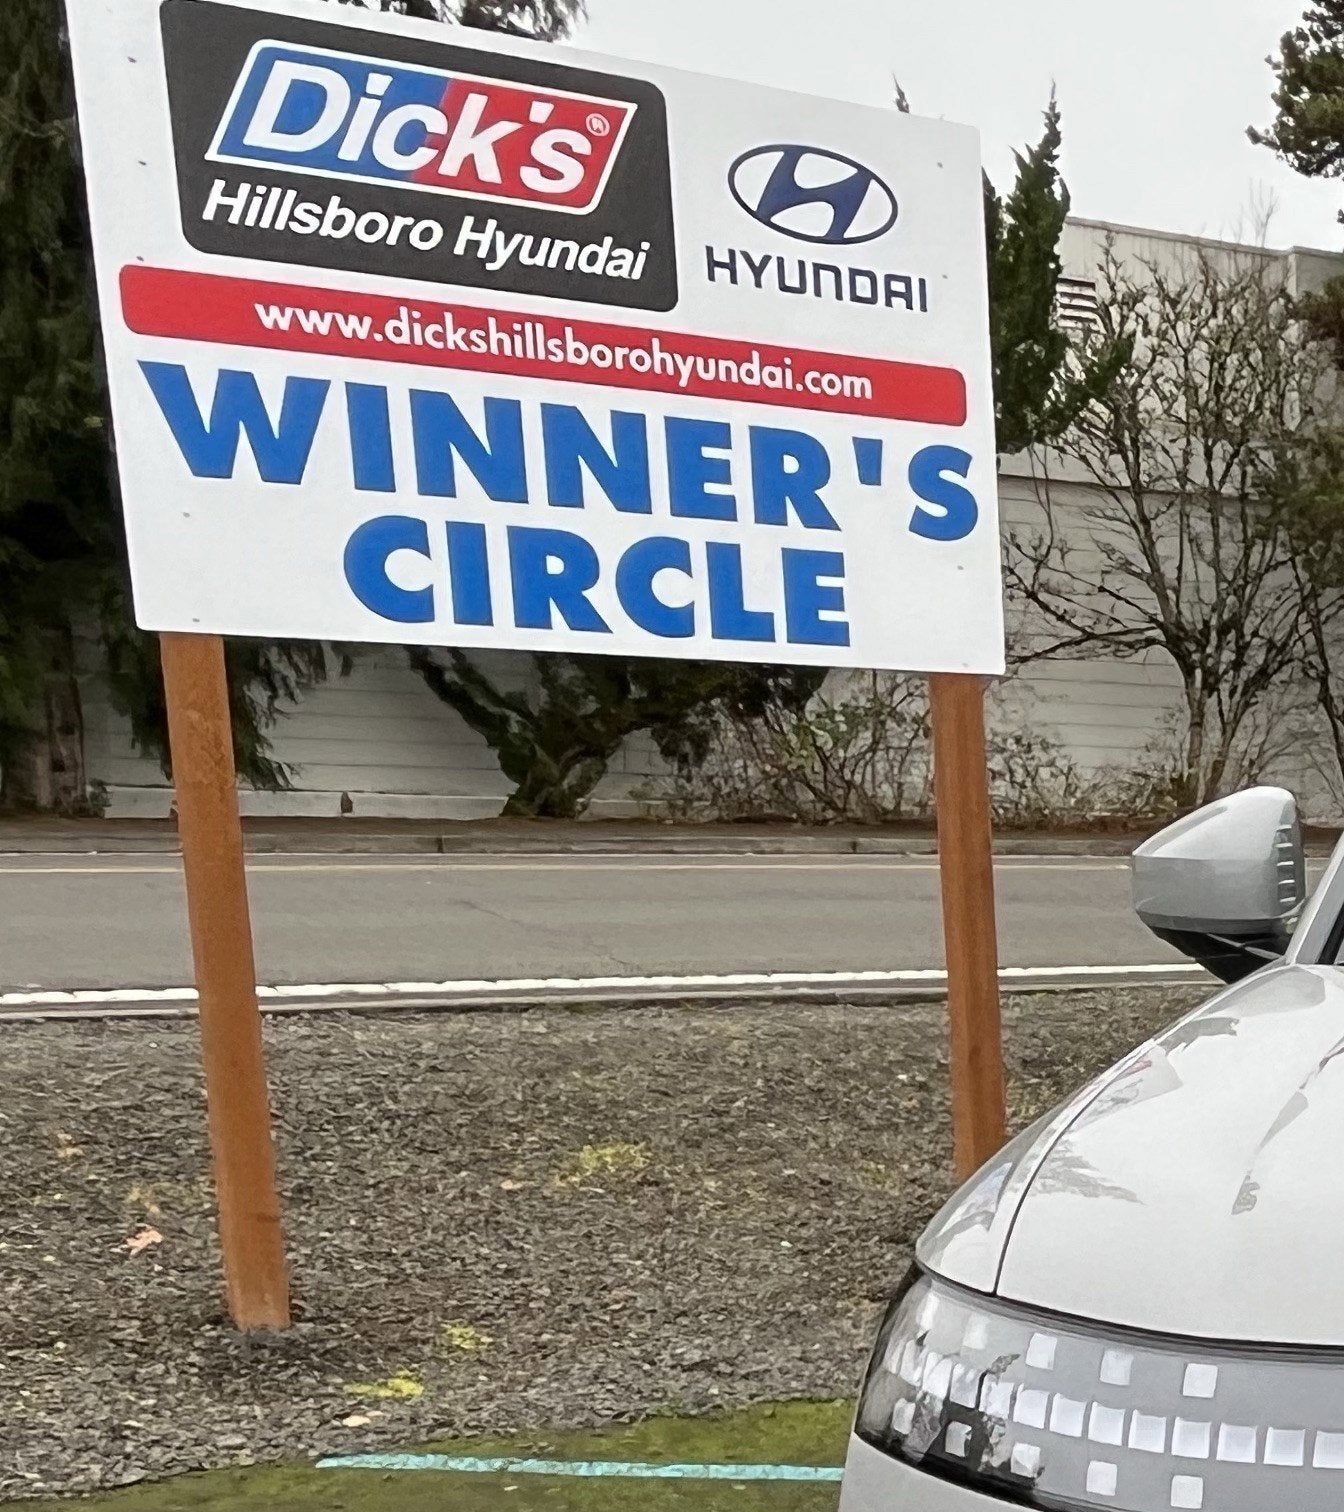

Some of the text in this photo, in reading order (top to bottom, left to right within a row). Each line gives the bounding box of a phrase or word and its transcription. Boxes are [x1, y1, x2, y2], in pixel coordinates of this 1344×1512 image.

[201, 178, 650, 280] Hillsboro Hyundai
[705, 245, 928, 312] HYUNDAI
[254, 297, 873, 400] www.dickshillsborohyundai.com
[137, 359, 979, 542] WINNER'S
[343, 515, 851, 648] CIRCLE
